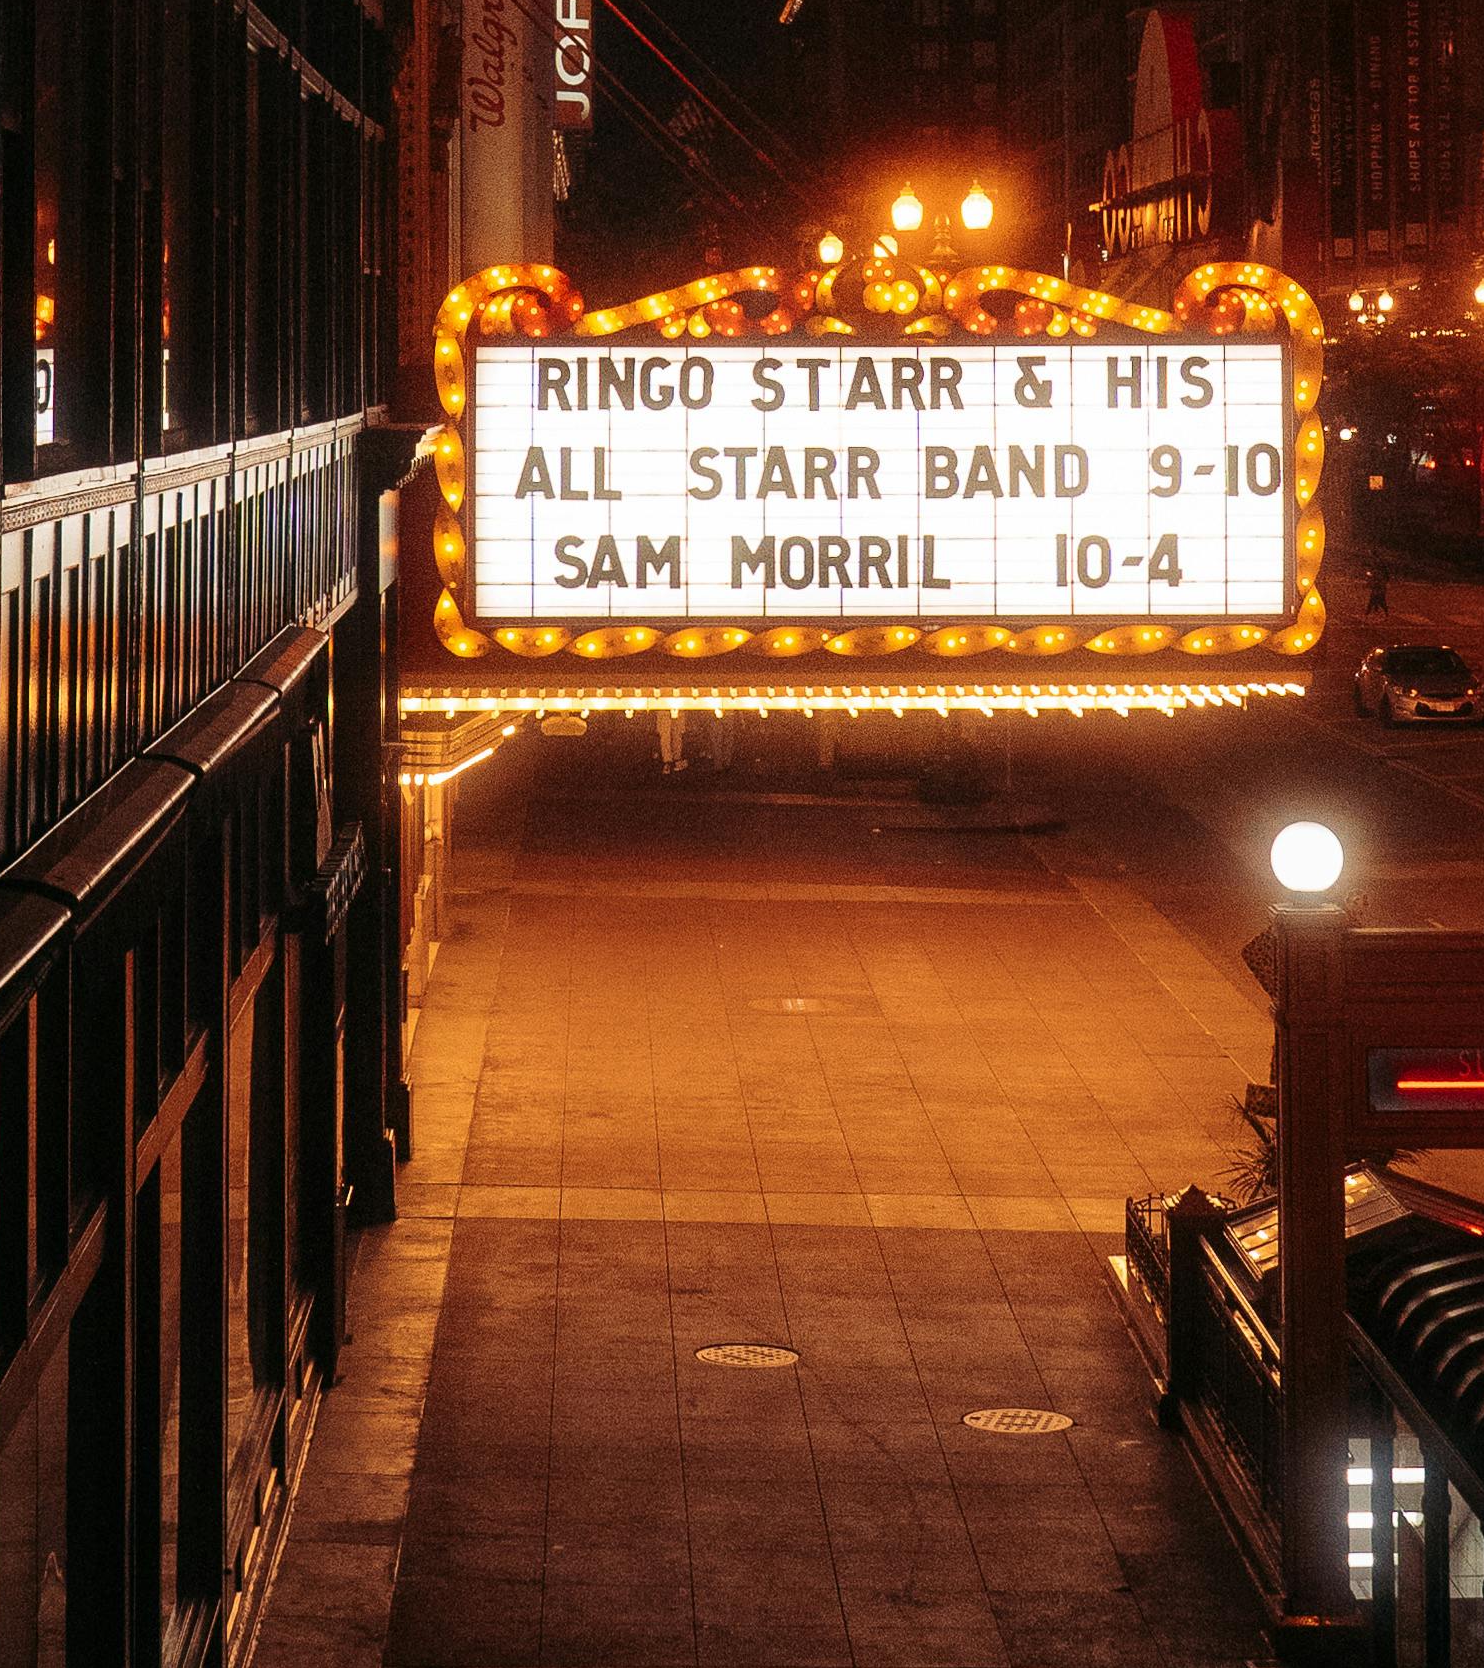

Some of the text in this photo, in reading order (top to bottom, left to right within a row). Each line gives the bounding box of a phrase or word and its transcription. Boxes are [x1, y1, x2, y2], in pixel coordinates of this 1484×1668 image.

[1370, 123, 1383, 201] SHOPPING
[536, 355, 1215, 413] RINGO STARR & HIS
[515, 442, 1282, 501] ALL STARR BAND 9-10
[554, 532, 1183, 591] SAM MORRIL 10-4
